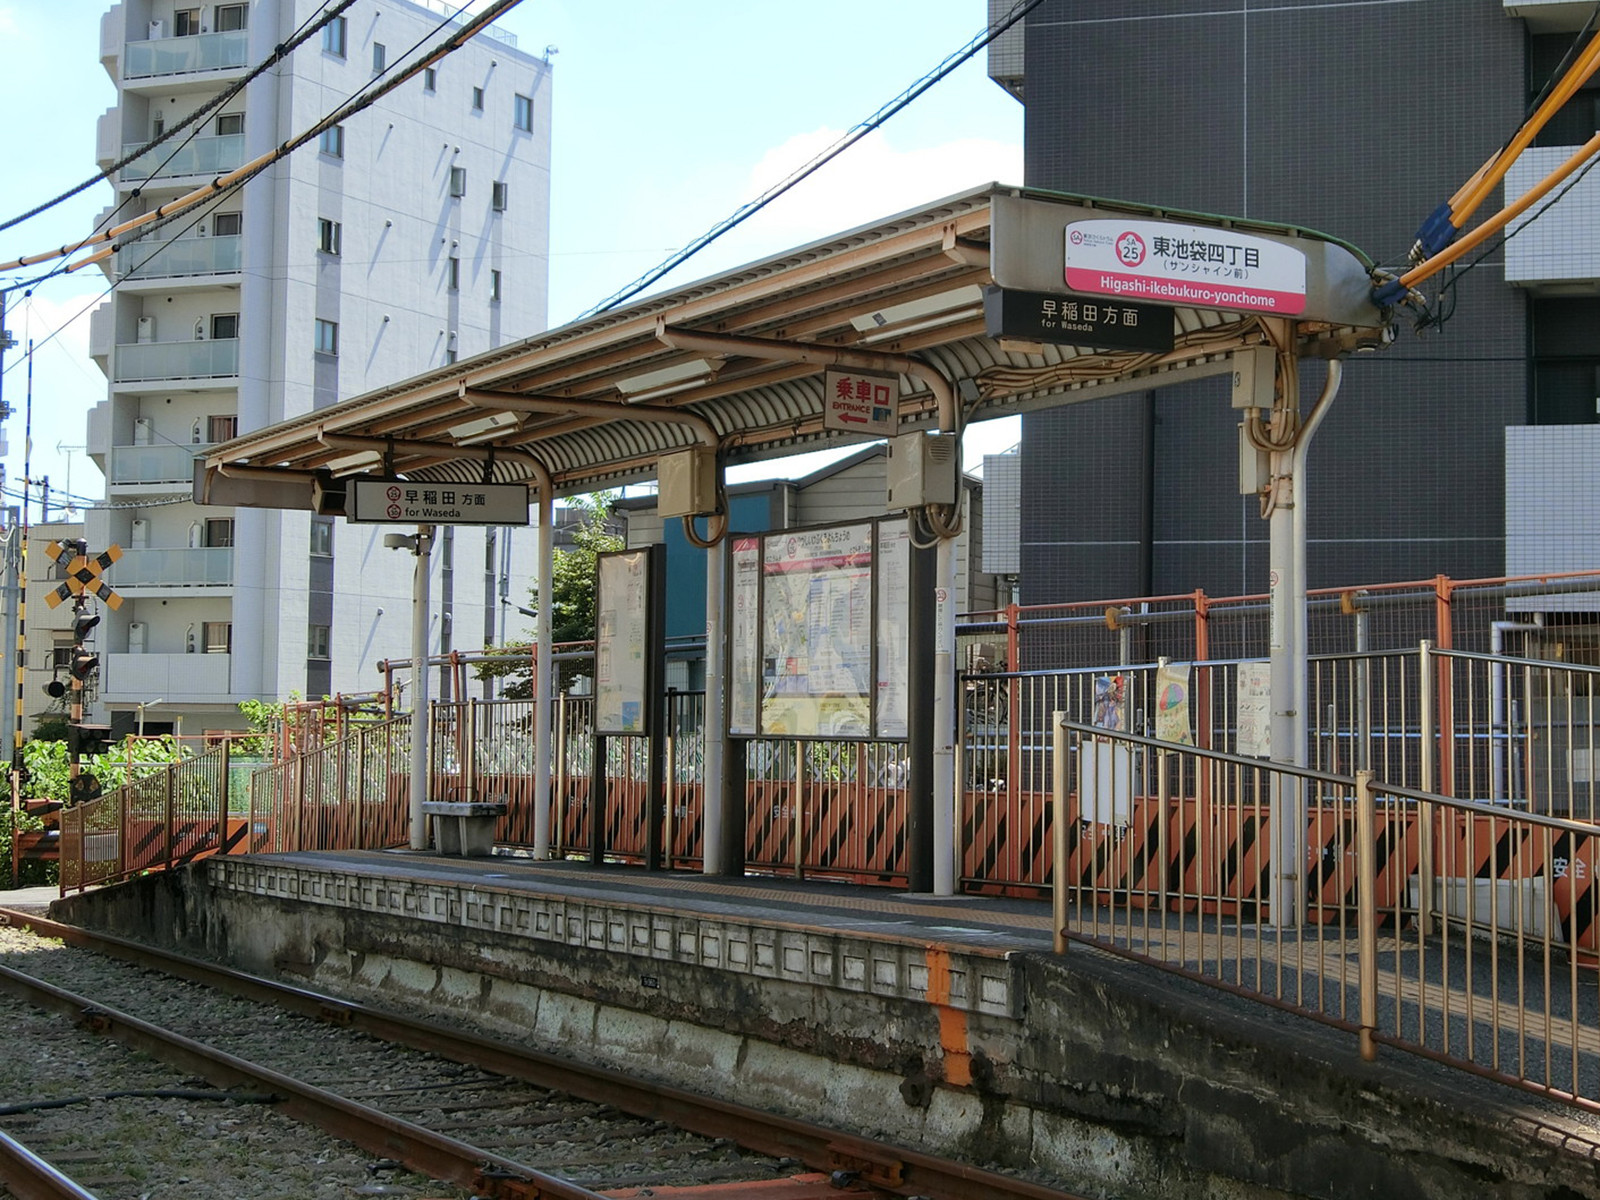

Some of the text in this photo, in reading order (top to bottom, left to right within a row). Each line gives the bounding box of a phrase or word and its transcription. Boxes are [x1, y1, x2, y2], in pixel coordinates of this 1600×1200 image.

[1126, 238, 1137, 246] SA
[1123, 246, 1139, 260] 25
[1152, 236, 1260, 269] 東池袋四丁目
[1100, 275, 1276, 308] Higashi-ikebukuro-yonchome
[1041, 299, 1139, 327] 早稲田方面
[1041, 318, 1093, 332] for Waseda
[836, 376, 890, 406] 乗車口
[832, 401, 871, 414] ENTRANCE
[404, 489, 486, 506] 早稲田方面
[405, 507, 461, 518] for Waseda
